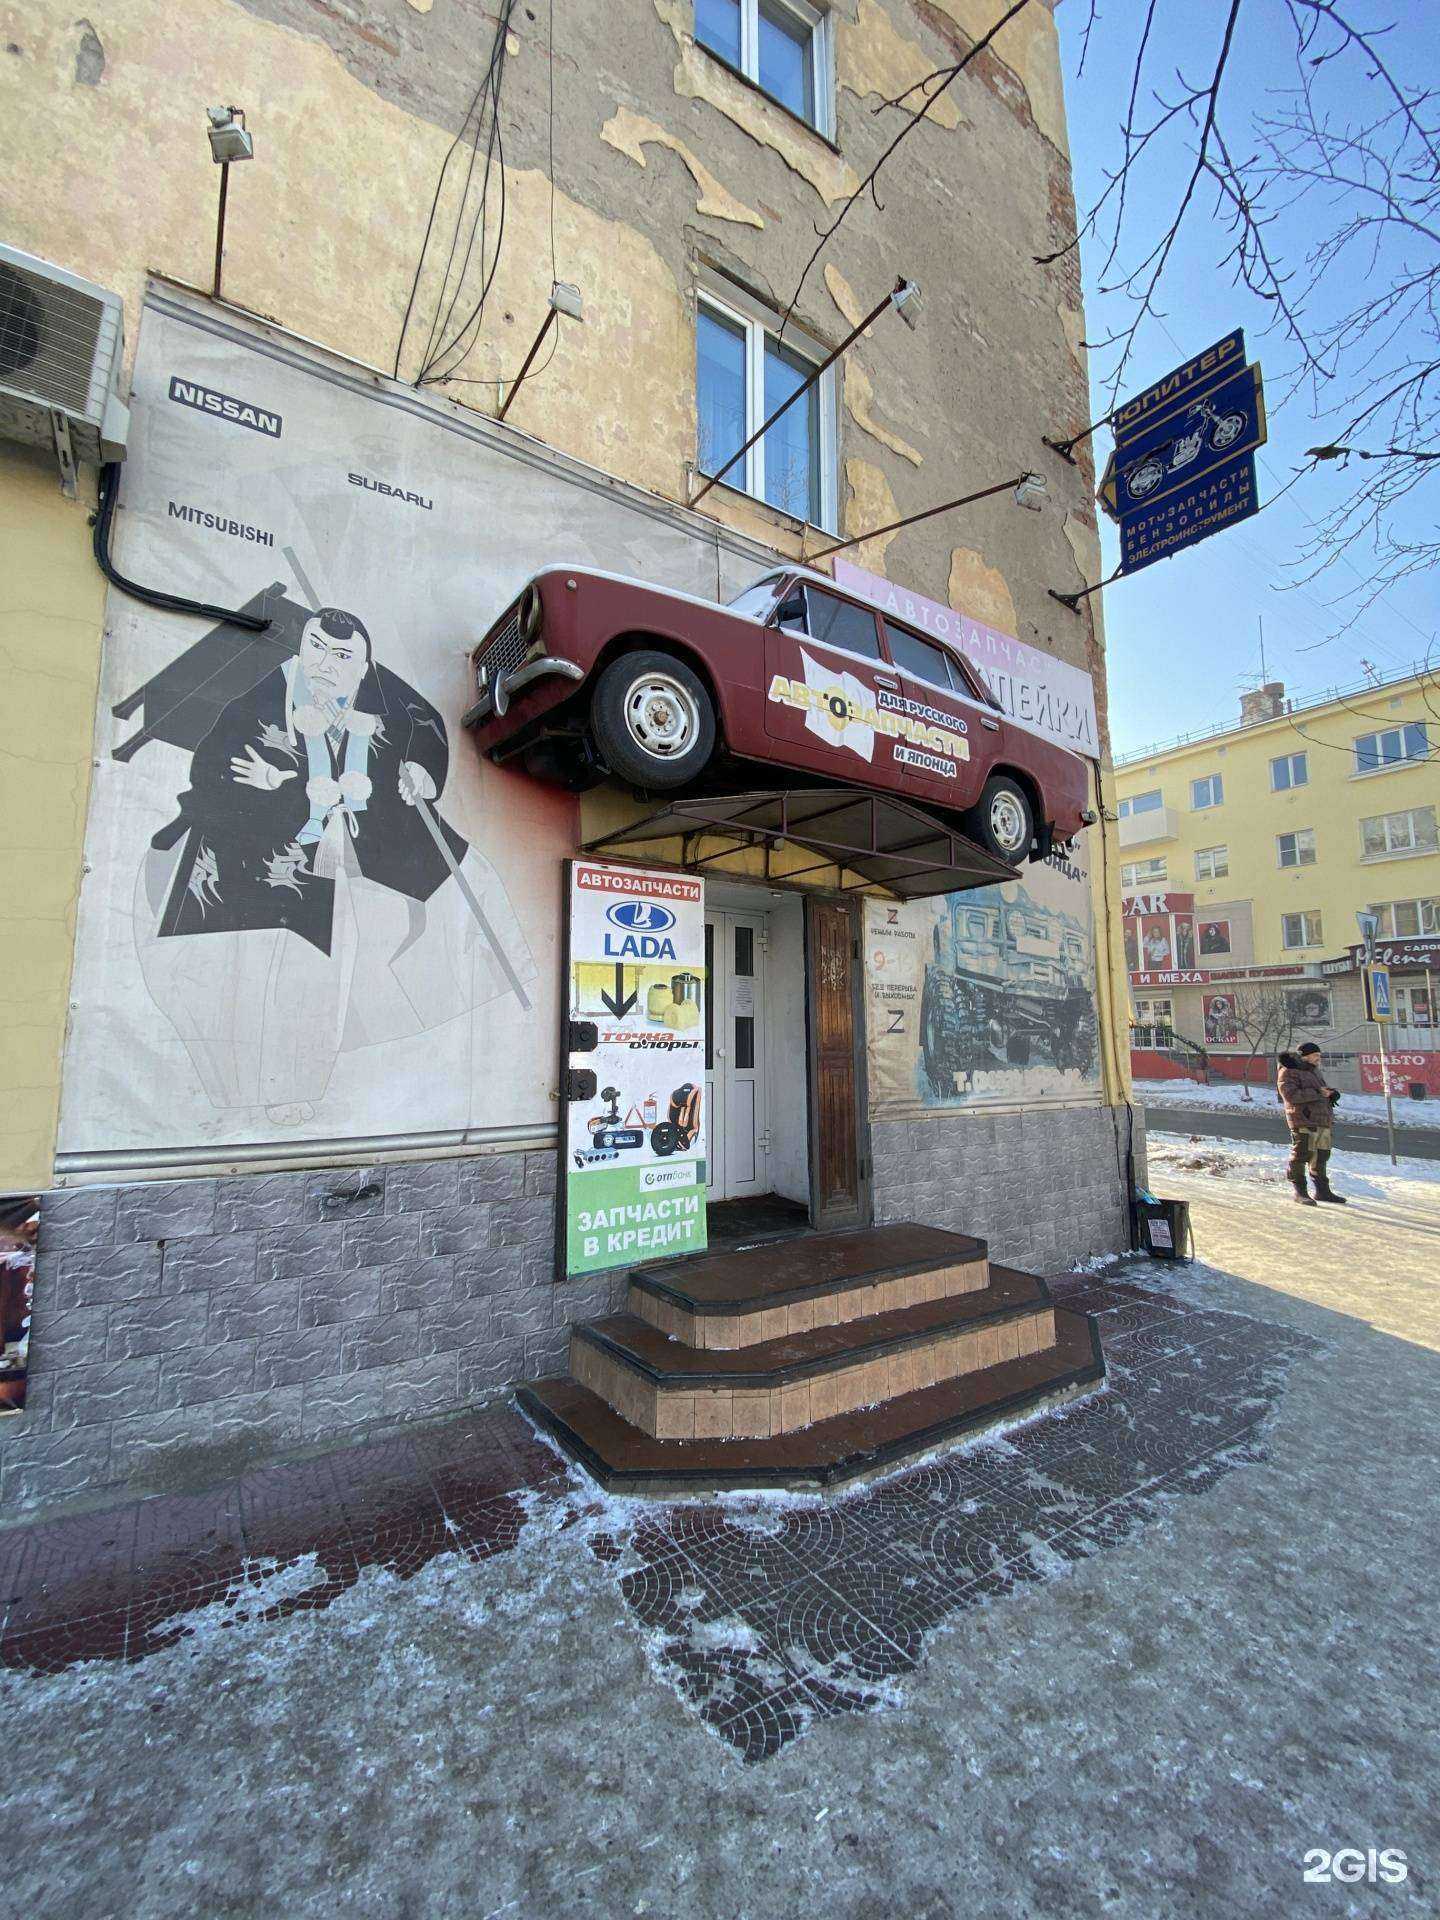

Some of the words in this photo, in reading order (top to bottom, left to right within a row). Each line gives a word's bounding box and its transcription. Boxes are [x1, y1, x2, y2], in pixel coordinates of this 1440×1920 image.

[1118, 339, 1237, 425] ЮПИТЕР
[173, 382, 278, 434] NISSAN
[347, 472, 433, 511] SUBARU
[1126, 466, 1250, 538] МОТОЗАПЧАСТИ
[168, 500, 274, 548] MITSUBISHI
[1128, 498, 1250, 564] ЭЛЕКТРОИНСТРУМЕНТ
[879, 691, 907, 710] ДЛЯ
[909, 703, 967, 733] РУССКОГО
[896, 746, 905, 760] И
[907, 751, 956, 776] ЯПОНЦА
[580, 872, 700, 899] АВТОЗАПЧАСТИ
[604, 933, 677, 961] LADA
[887, 984, 917, 992] ПЕРЕРЫВА
[1140, 975, 1150, 983] И
[1158, 972, 1203, 983] МЕХА
[577, 1195, 699, 1232] ЗАПЧАСТИ
[584, 1236, 600, 1257] В
[608, 1219, 695, 1253] КРЕДИТ
